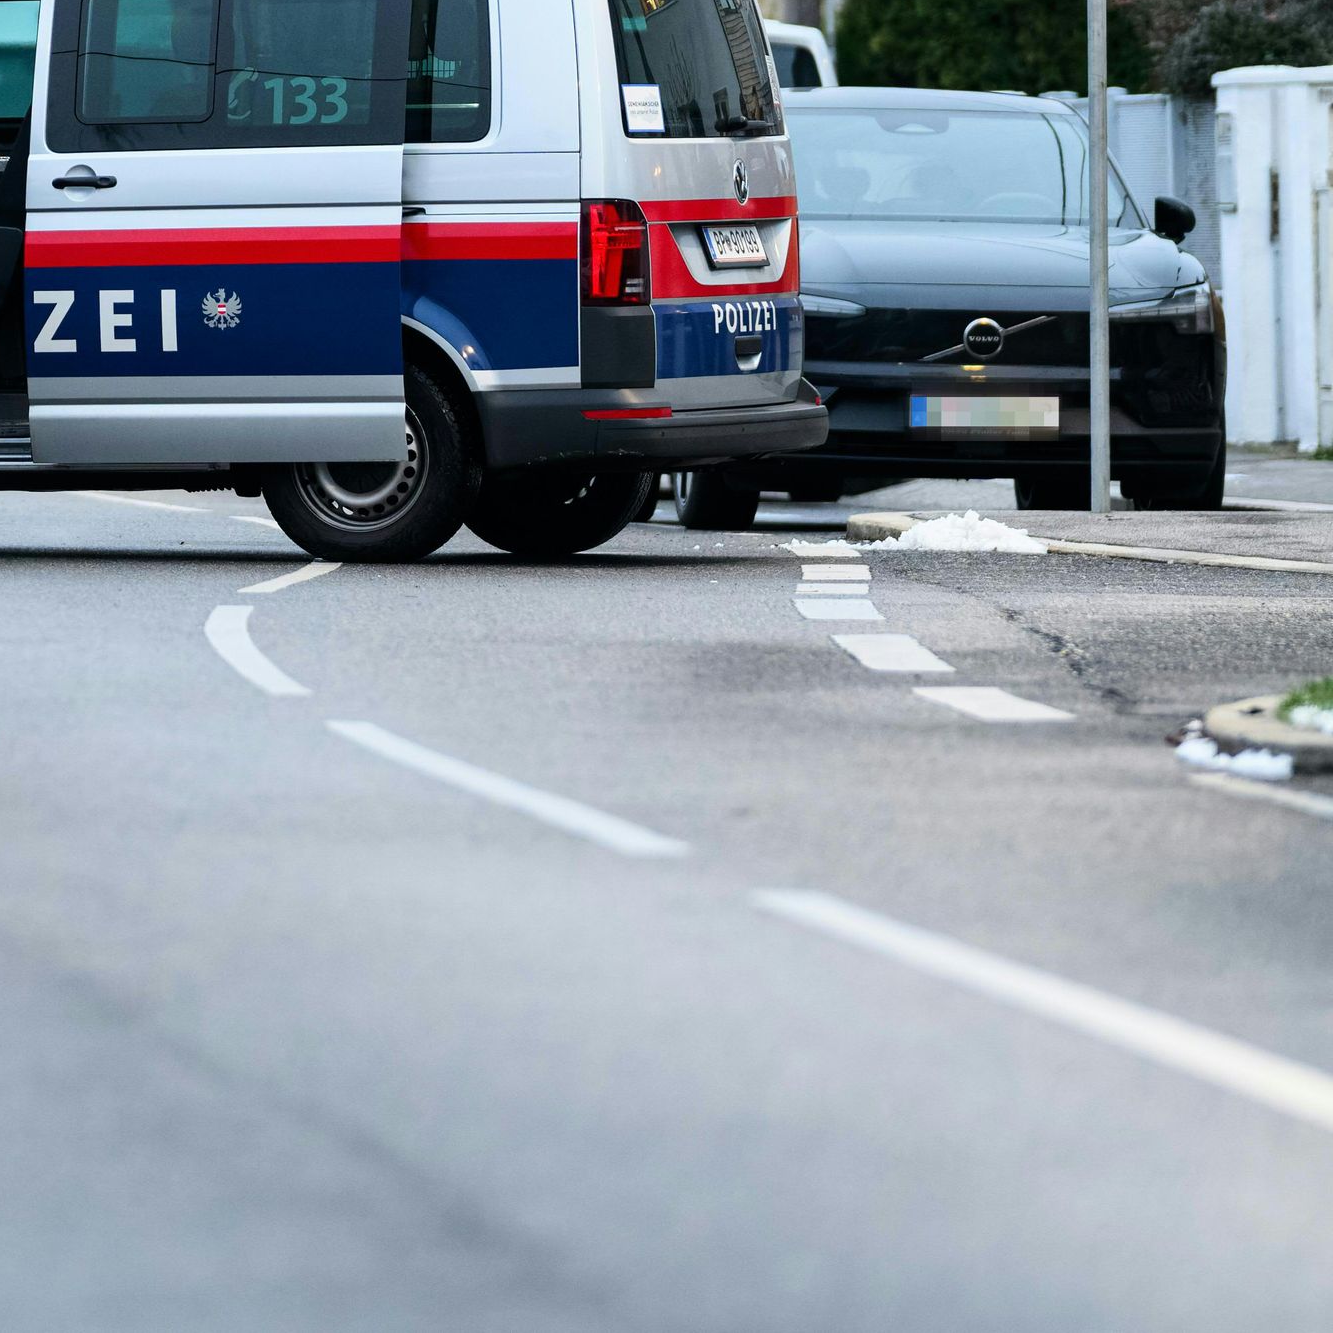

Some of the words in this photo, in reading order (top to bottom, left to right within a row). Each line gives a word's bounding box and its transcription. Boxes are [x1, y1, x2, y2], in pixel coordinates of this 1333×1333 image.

[264, 76, 348, 124] 133
[729, 229, 760, 254] 90199
[33, 288, 178, 353] ZEI
[711, 300, 777, 334] POLIZEI
